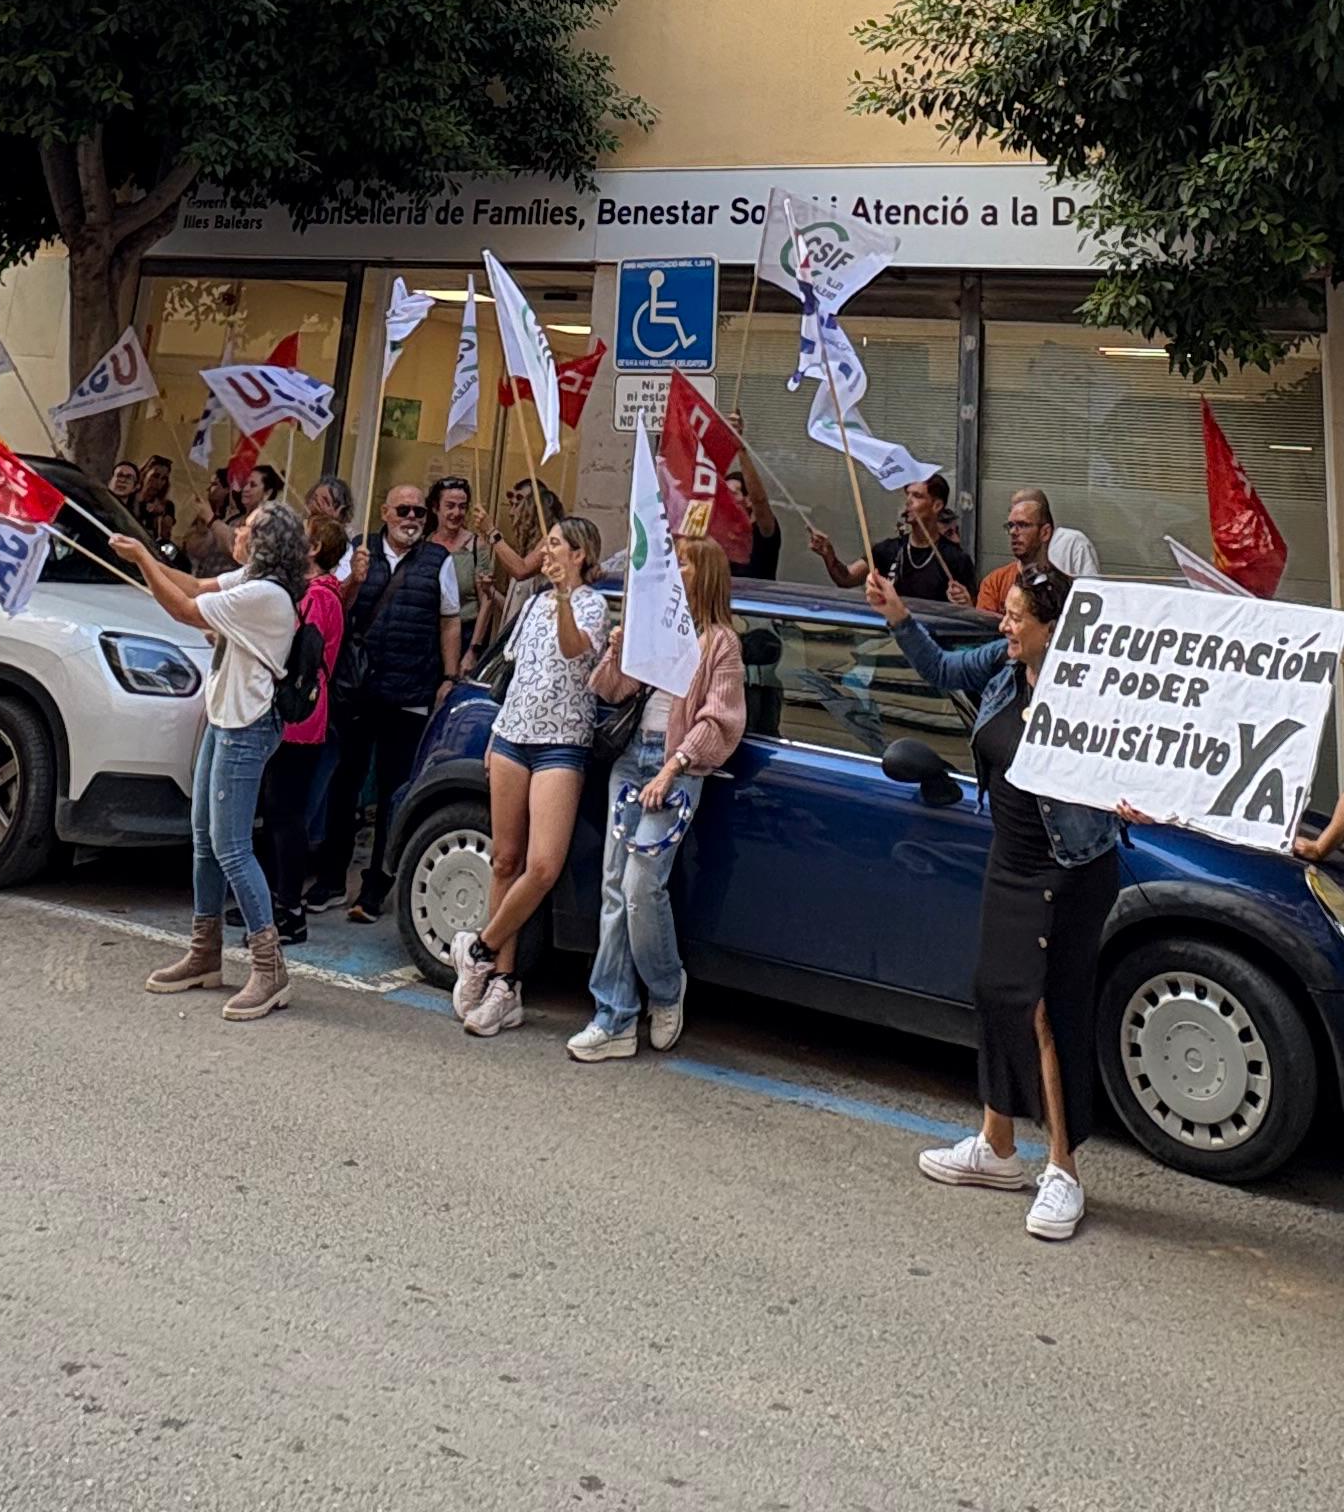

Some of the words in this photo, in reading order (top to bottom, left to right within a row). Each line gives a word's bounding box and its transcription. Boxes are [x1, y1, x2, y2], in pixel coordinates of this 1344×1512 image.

[183, 214, 210, 230] Illes
[213, 214, 264, 230] Balears
[435, 198, 463, 226] de
[472, 197, 586, 231] Famílies,
[597, 198, 720, 226] Benestar
[851, 194, 969, 227] Atenció
[980, 203, 999, 226] a
[1010, 196, 1039, 226] la
[1053, 661, 1091, 688] DE
[1098, 667, 1210, 708] PODER
[1025, 701, 1231, 777] ADQUISITIVO
